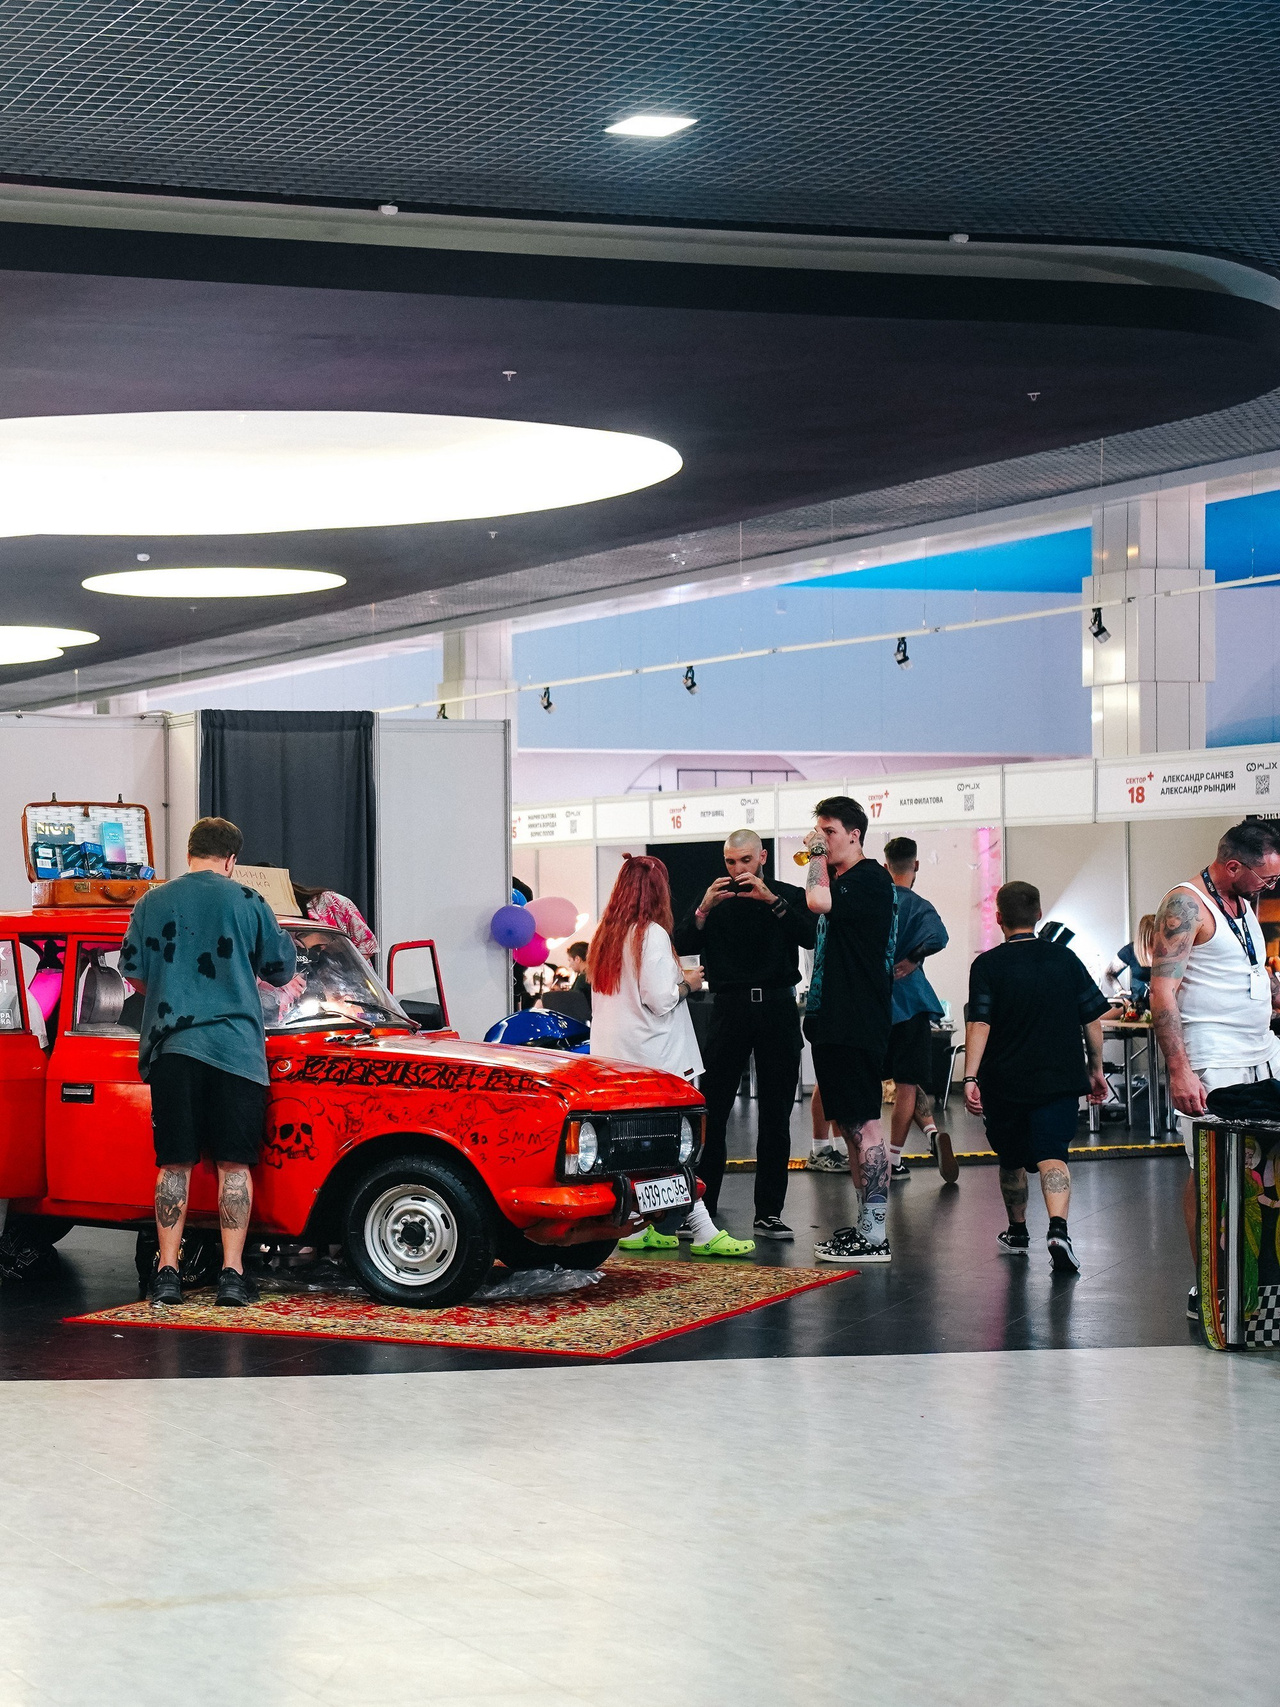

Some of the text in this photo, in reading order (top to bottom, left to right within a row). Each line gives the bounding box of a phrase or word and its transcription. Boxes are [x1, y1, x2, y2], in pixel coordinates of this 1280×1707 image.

[1125, 777, 1147, 785] СЕКТОР
[1162, 770, 1234, 783] АЛЕКСАНДР САНЧЕЗ
[1128, 786, 1146, 804] 18
[1160, 783, 1236, 796] АЛЕКСАНДР РЫНДИН
[900, 796, 944, 806] КАТЯ ФИЛАТОВА
[870, 802, 883, 819] 17
[671, 815, 682, 829] 16
